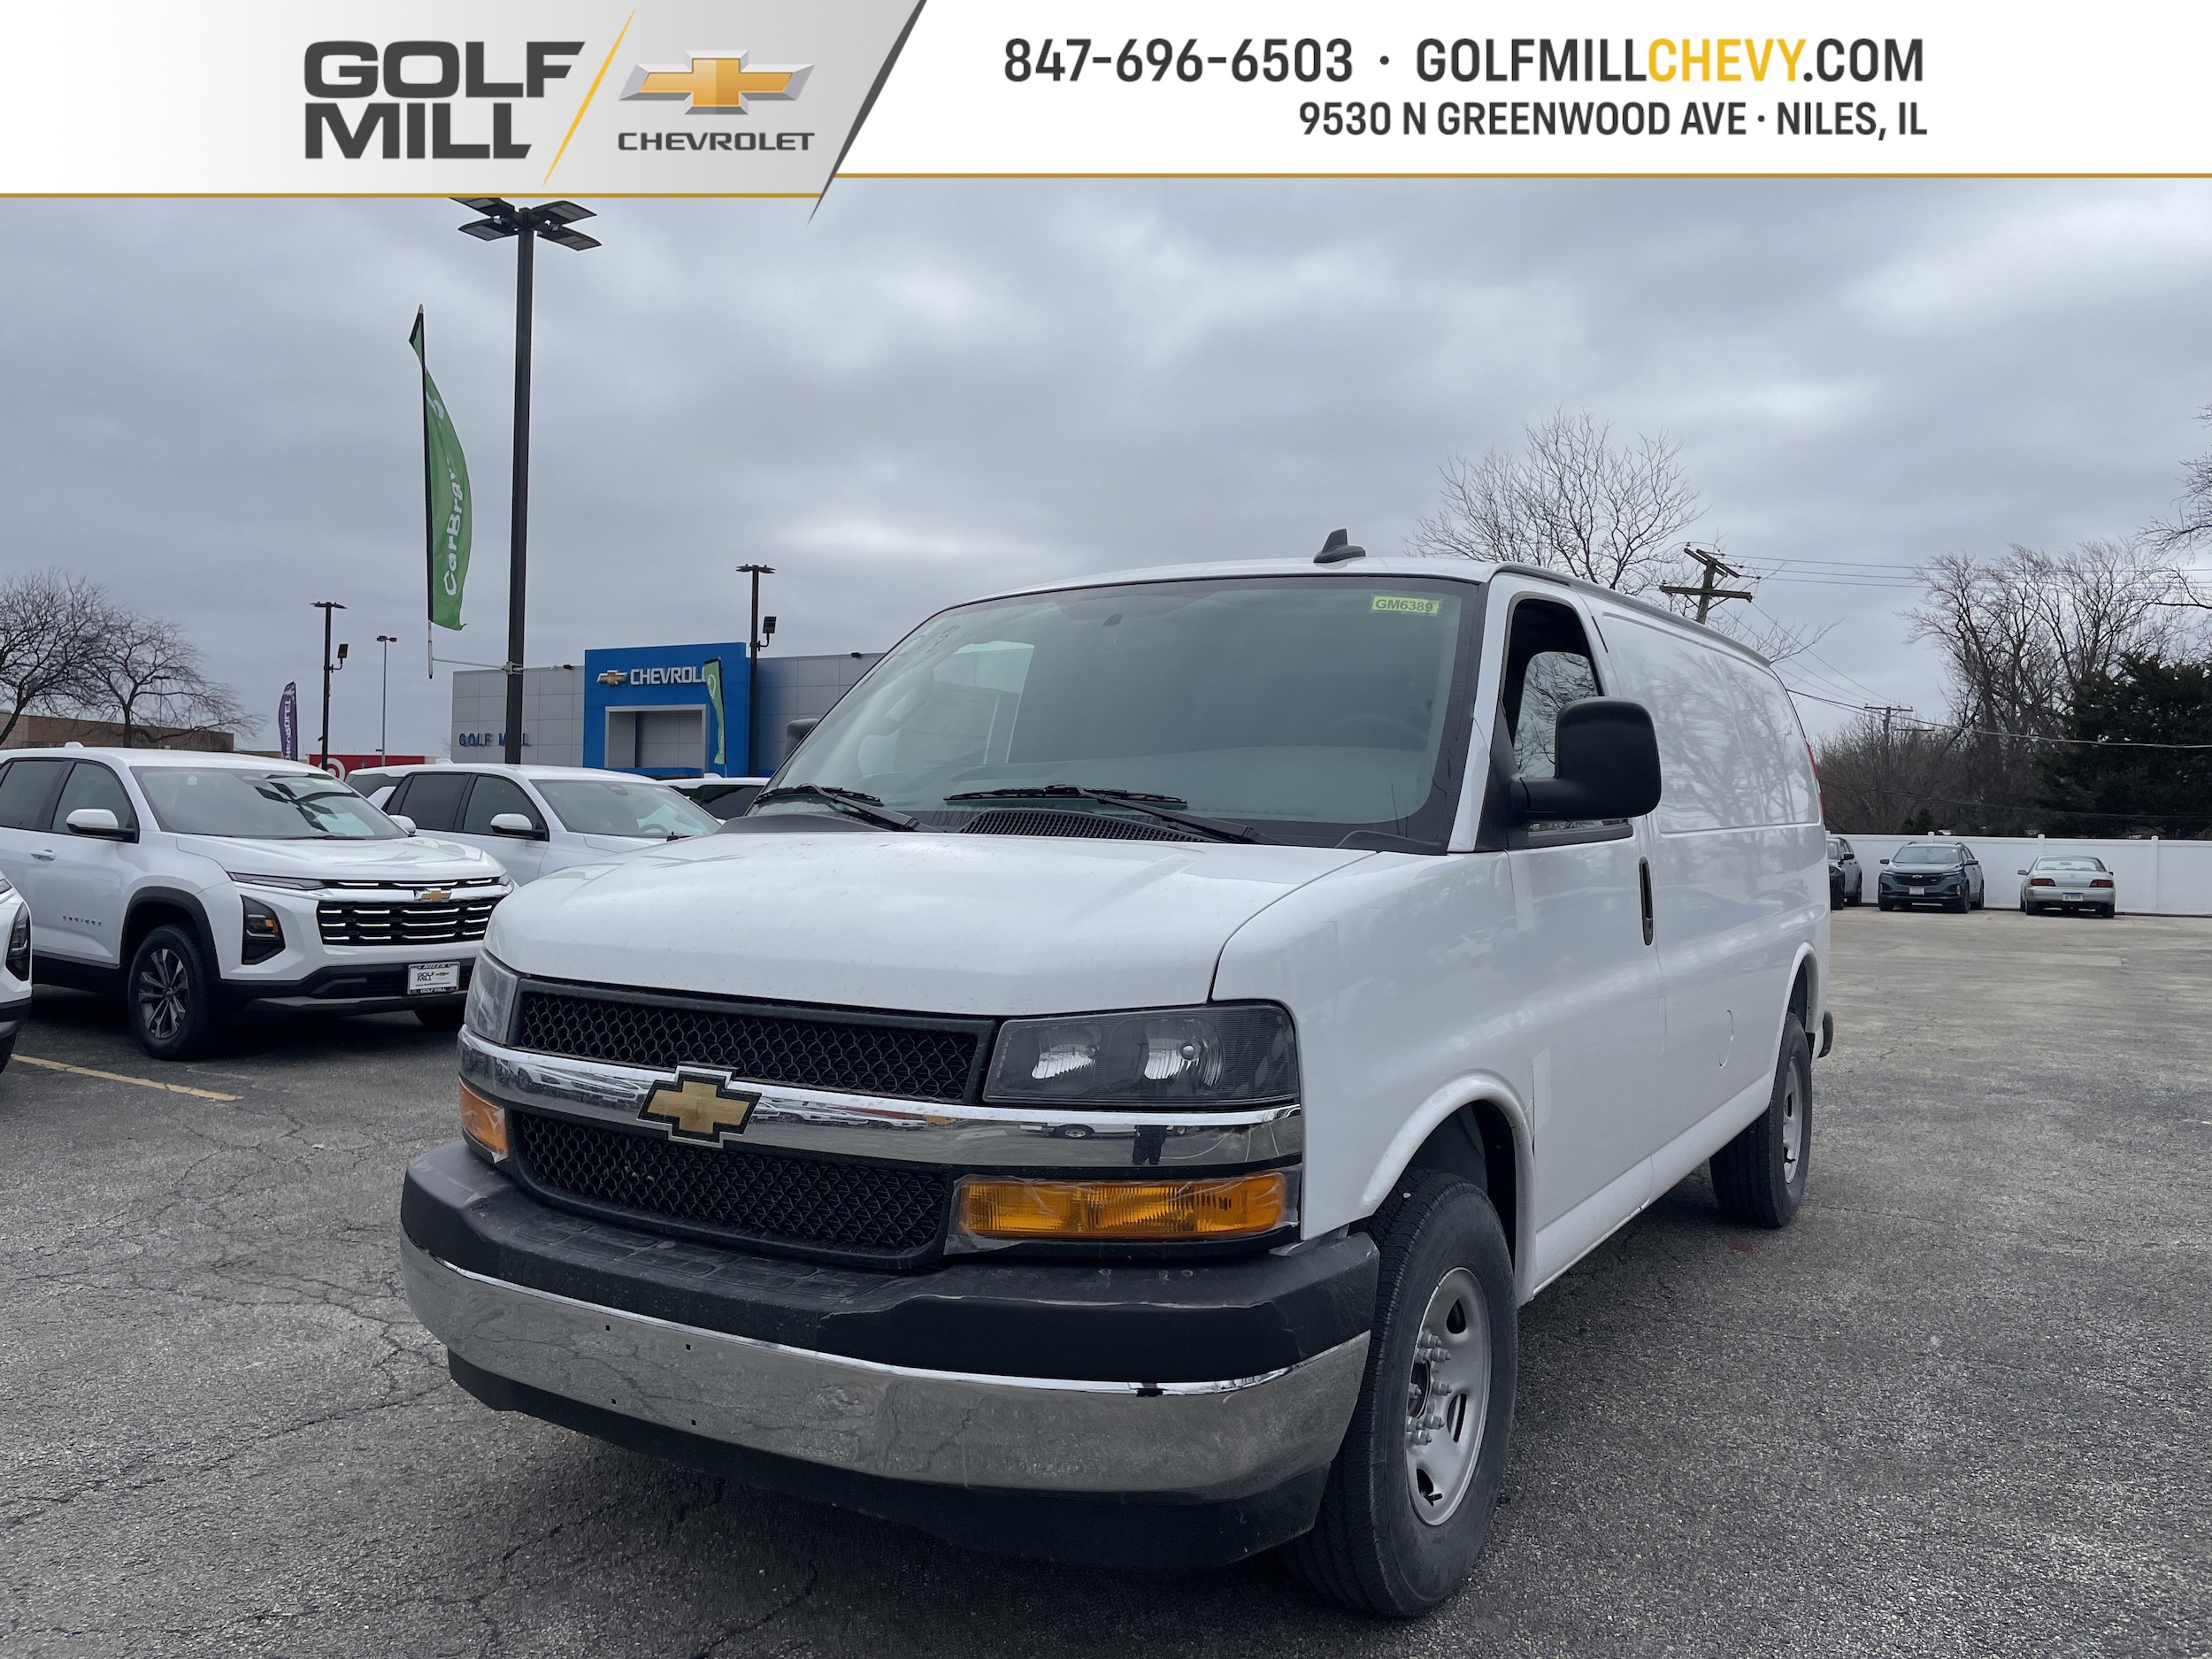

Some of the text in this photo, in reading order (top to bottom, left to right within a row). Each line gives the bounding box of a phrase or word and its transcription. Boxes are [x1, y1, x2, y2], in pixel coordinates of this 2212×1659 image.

[1375, 599, 1433, 612] GM6389
[630, 666, 706, 686] CHEVROL
[459, 733, 531, 747] GOLF ML
